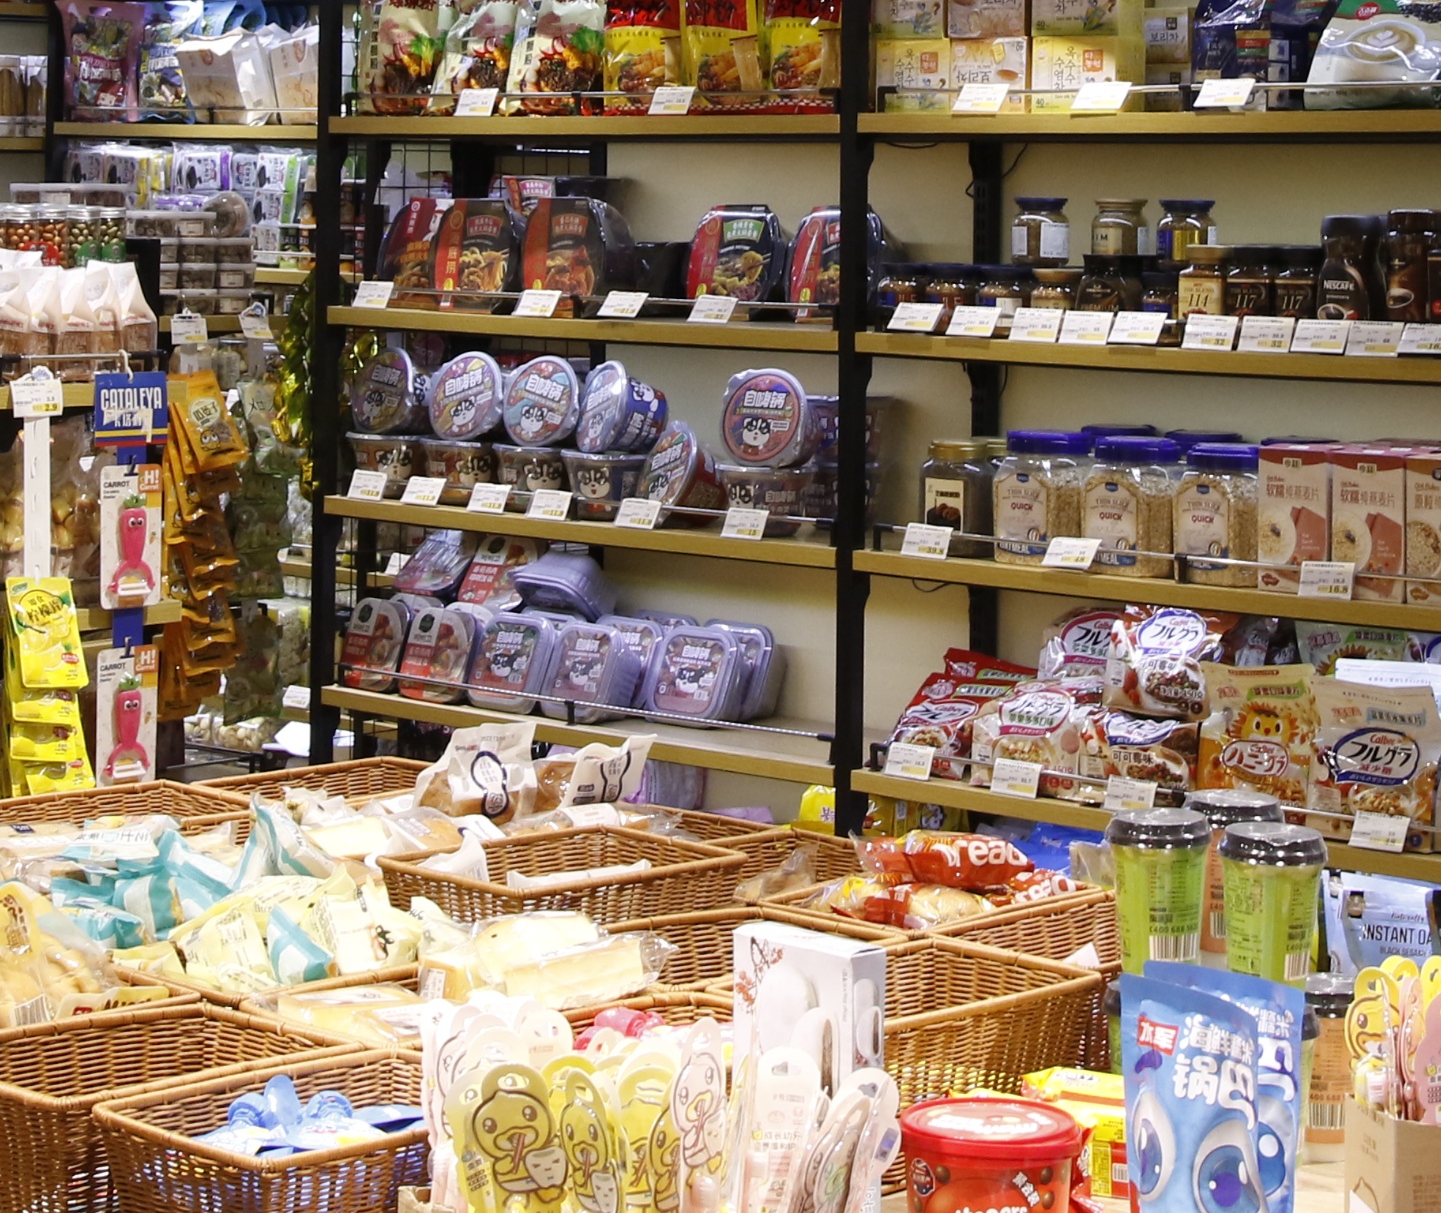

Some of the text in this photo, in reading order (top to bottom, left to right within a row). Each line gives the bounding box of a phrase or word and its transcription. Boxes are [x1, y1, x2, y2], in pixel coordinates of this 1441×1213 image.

[1188, 293, 1209, 309] 114
[1236, 294, 1256, 309] 117
[1282, 295, 1303, 310] 117
[100, 386, 162, 410] CATALEYA
[742, 389, 787, 409] 自嗨锅
[103, 480, 130, 489] CARROT
[1010, 502, 1034, 512] QUICK
[1098, 511, 1123, 522] QUICK
[1191, 514, 1215, 524] QUICK
[1327, 585, 1349, 594] 16.8
[99, 661, 127, 672] CARROT
[1370, 734, 1396, 746] Calbee
[1349, 739, 1413, 766] フルグラ
[1223, 748, 1287, 777] ハニーグラ
[1172, 1055, 1255, 1114] 锅巴
